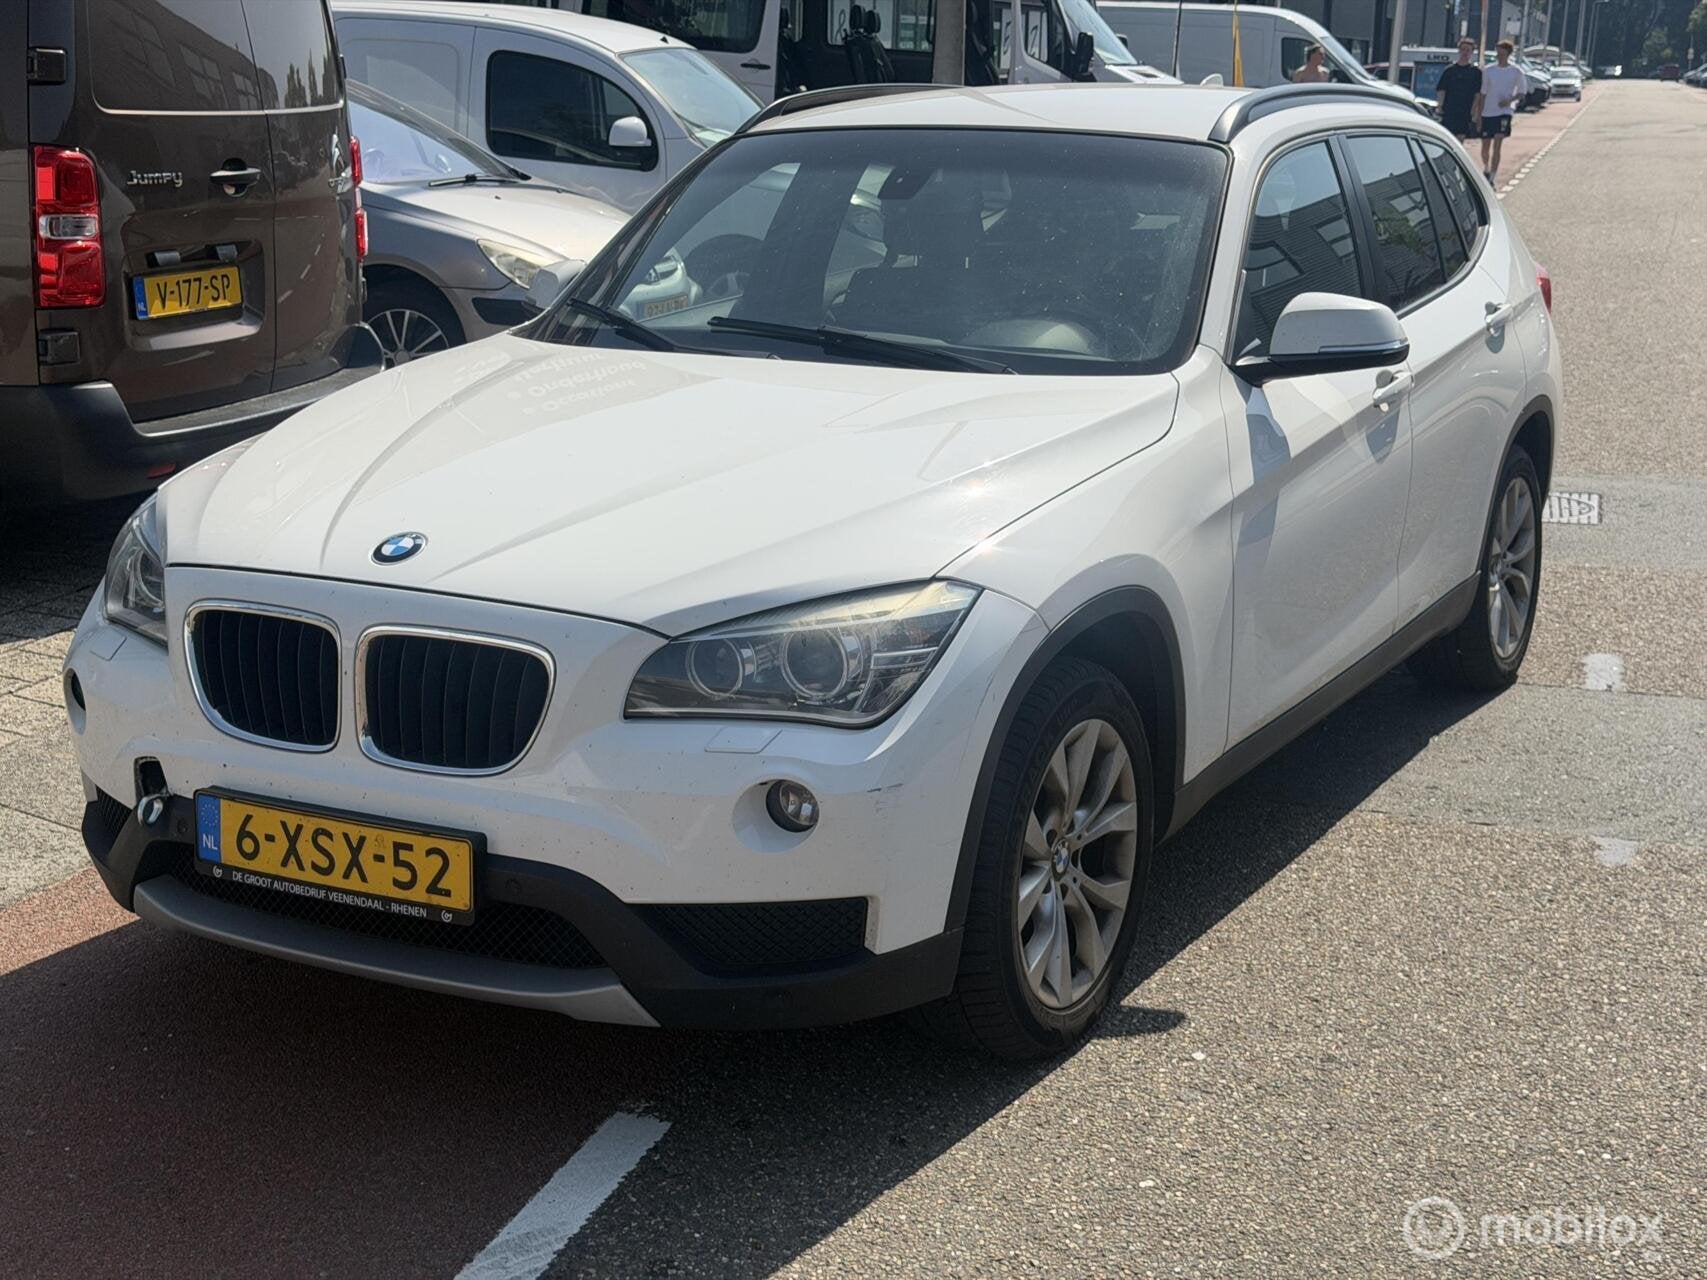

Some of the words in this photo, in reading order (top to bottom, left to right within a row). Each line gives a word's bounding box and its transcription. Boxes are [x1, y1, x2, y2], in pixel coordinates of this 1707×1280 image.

[127, 170, 183, 188] Jumpy
[156, 273, 231, 310] V-177-SP
[202, 833, 218, 851] NL
[236, 813, 452, 898] 6-XSX-52
[232, 871, 243, 881] DE
[244, 873, 272, 889] GROOT
[273, 879, 327, 901] AUTOBEDRIJF
[327, 890, 385, 911] VEENENDAAL
[391, 902, 427, 918] RHENEN
